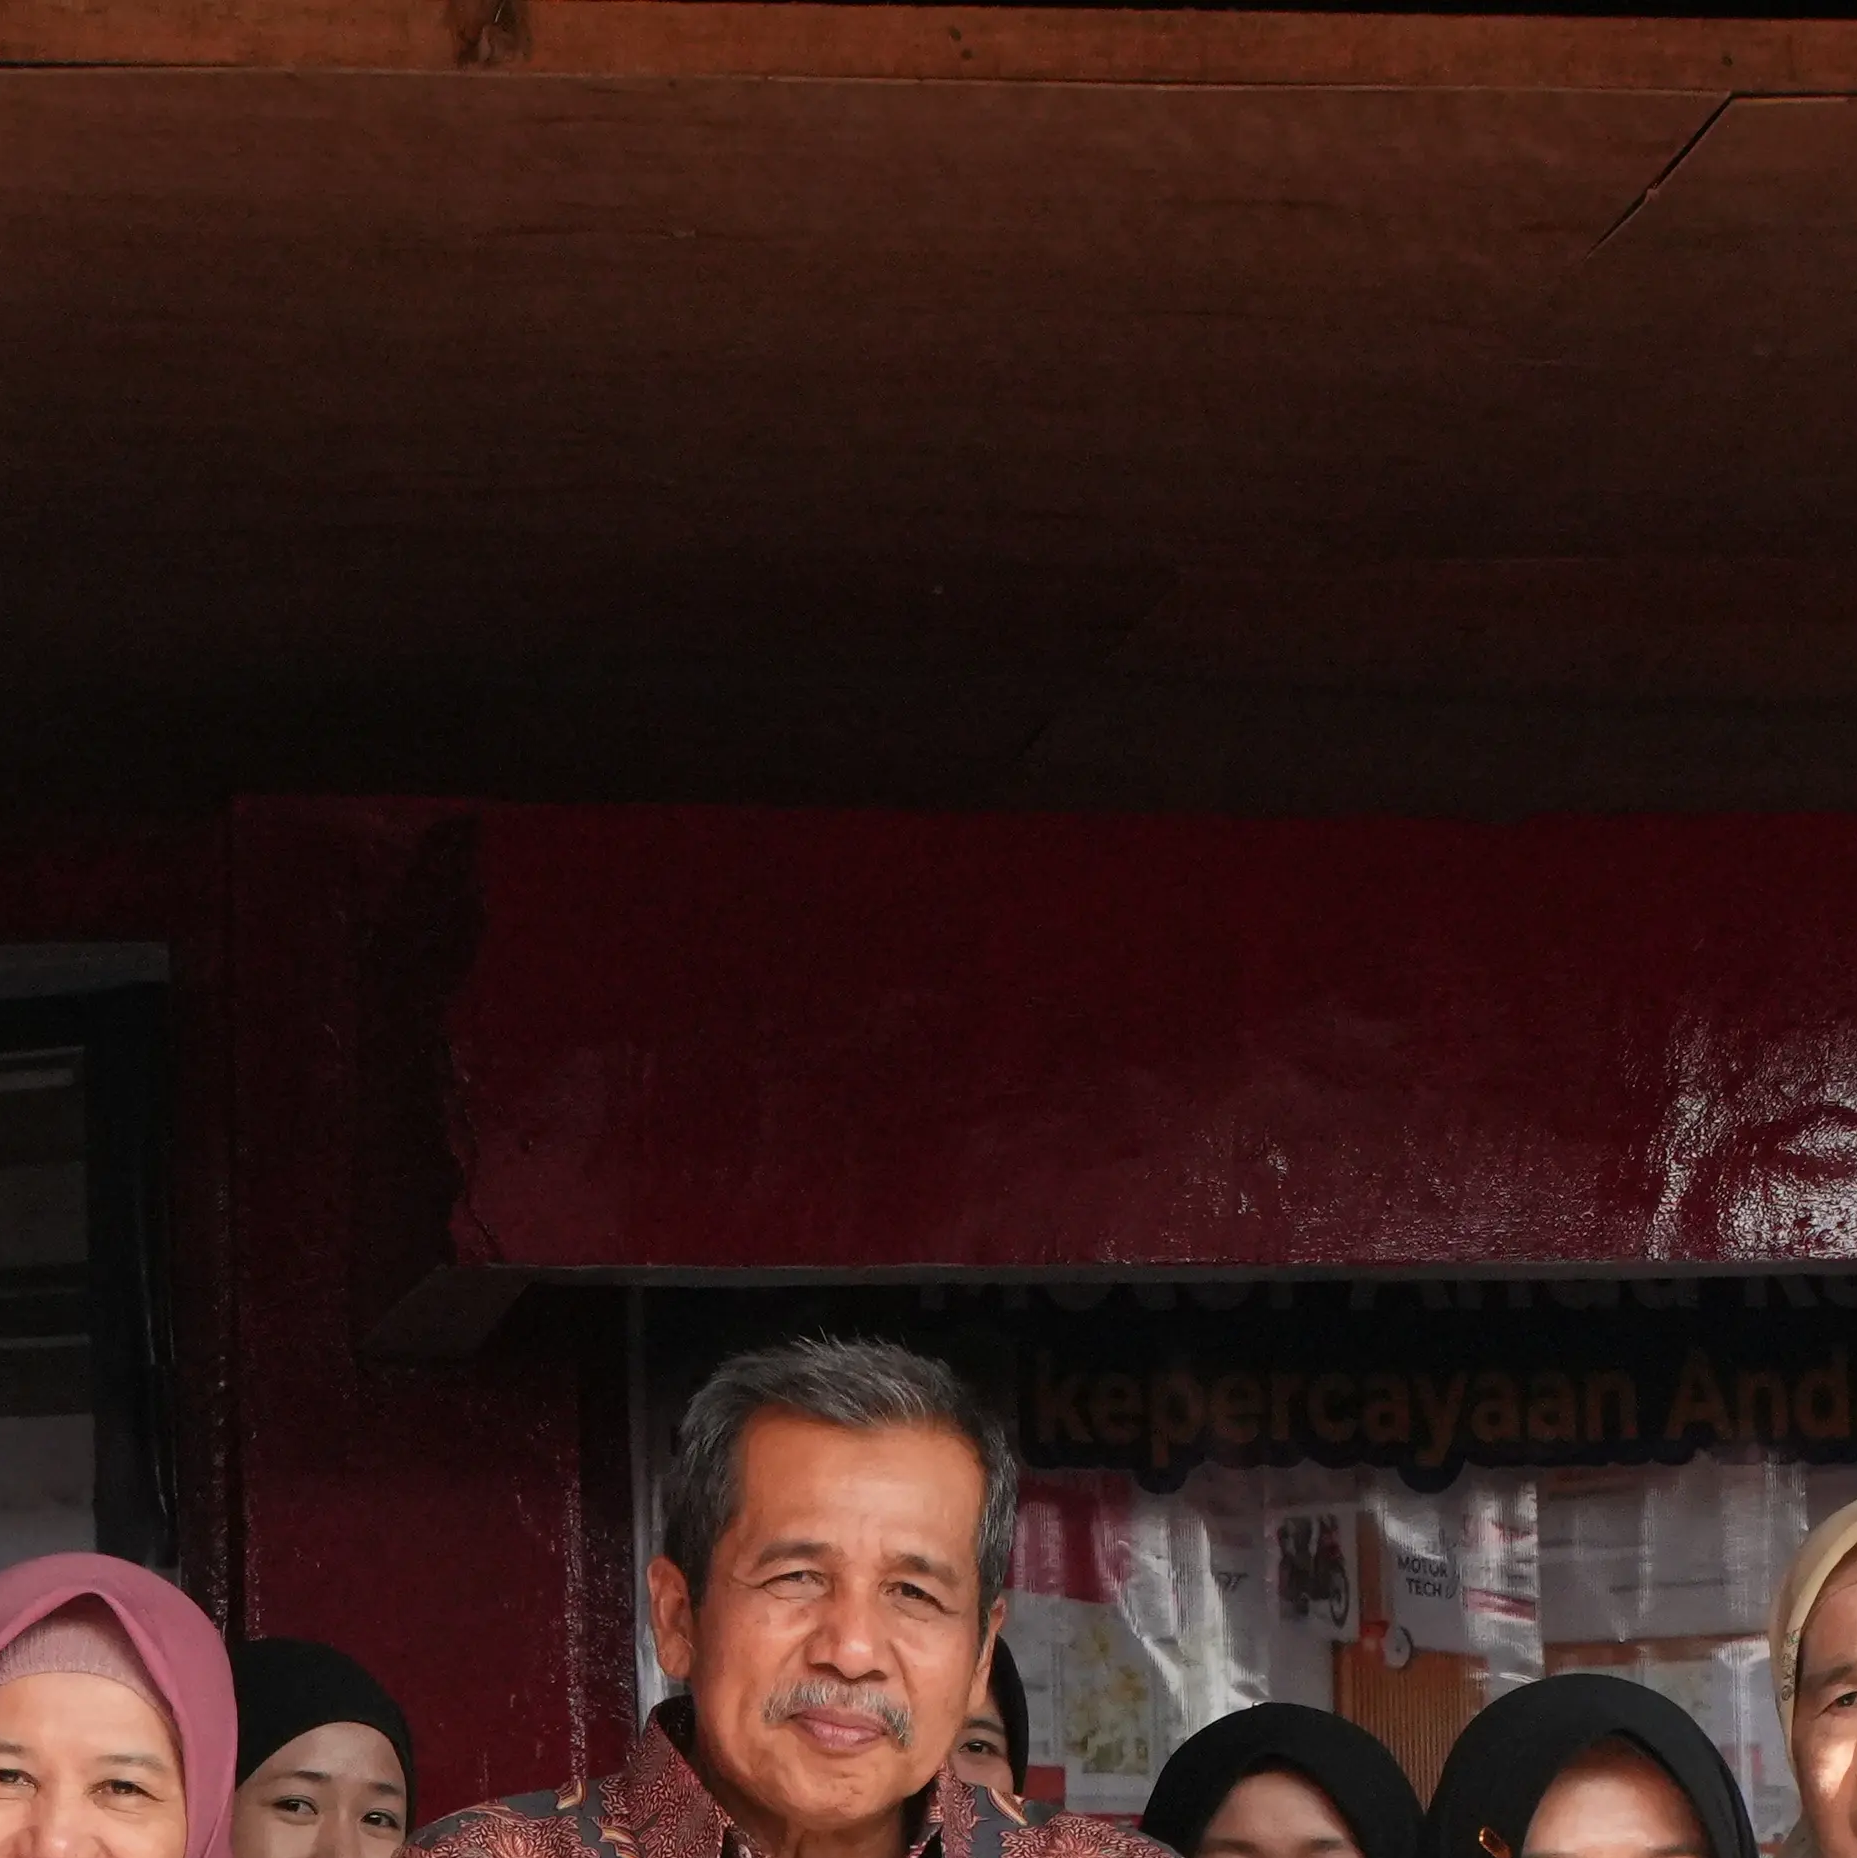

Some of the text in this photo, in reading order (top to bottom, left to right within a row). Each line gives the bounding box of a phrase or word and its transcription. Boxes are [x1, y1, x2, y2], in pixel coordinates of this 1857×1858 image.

[1034, 1349, 1639, 1469] kepercayaan
[1397, 1556, 1448, 1577] MOTOR
[1406, 1577, 1442, 1597] TECH
